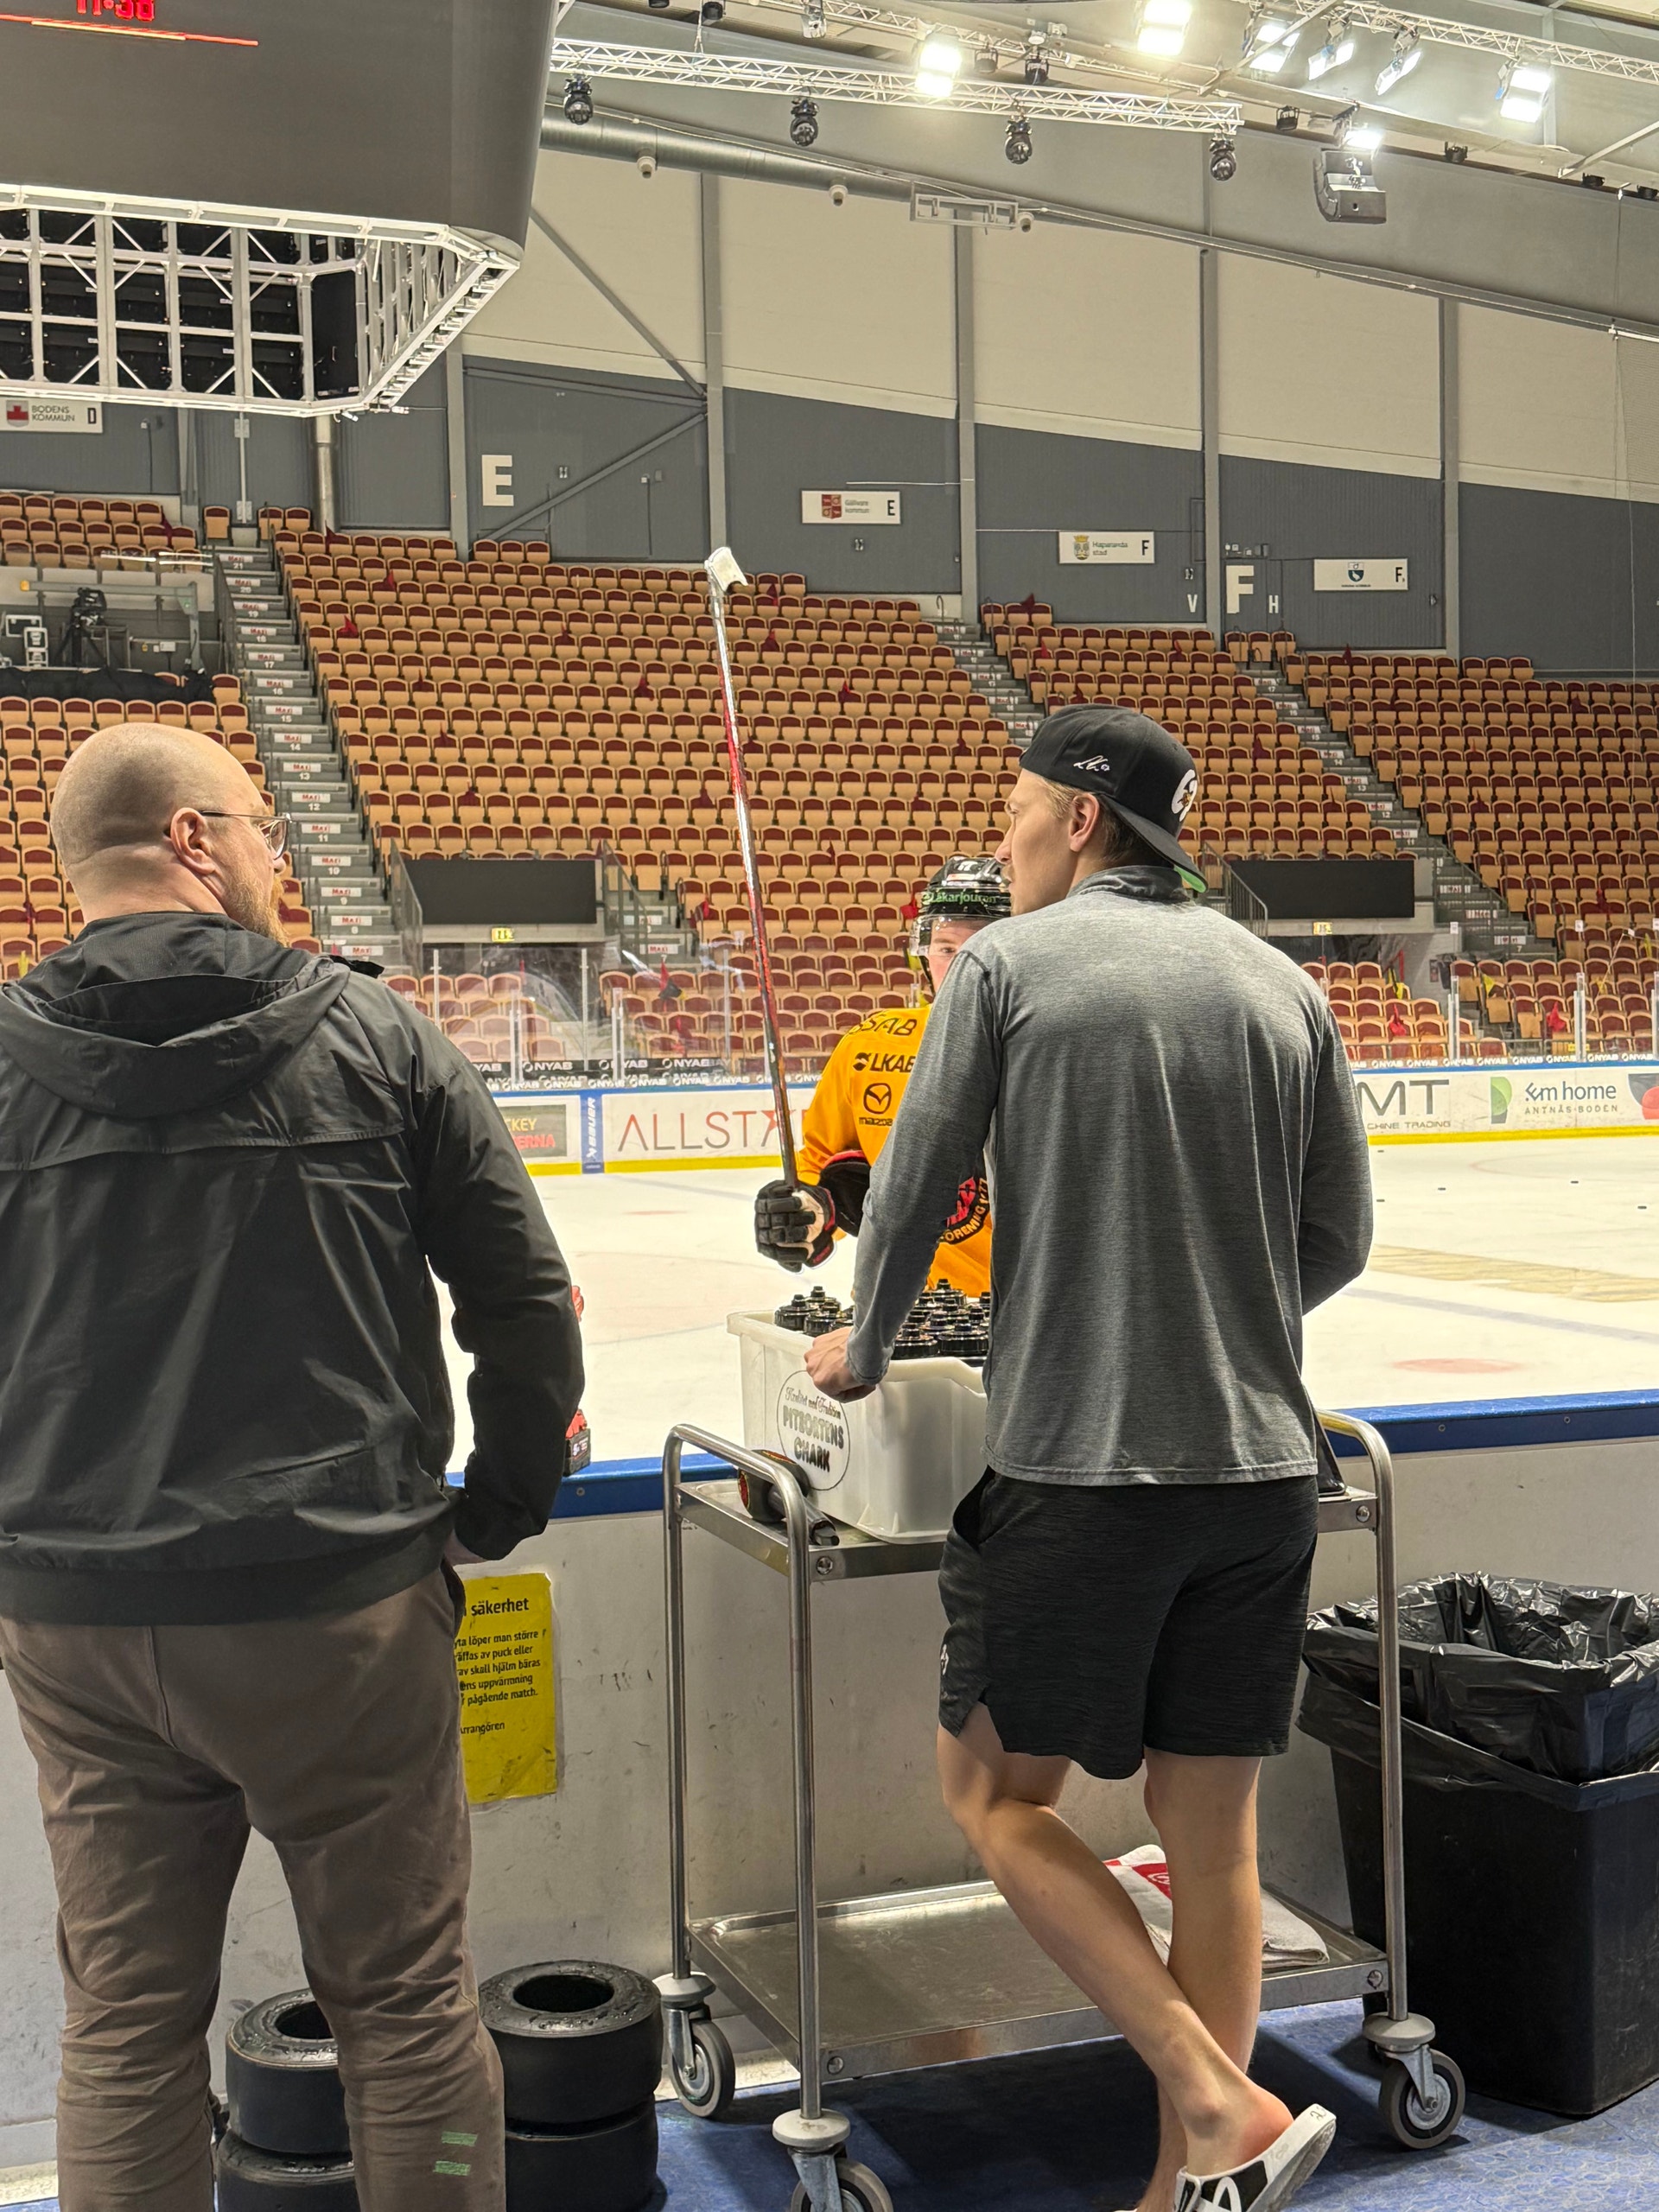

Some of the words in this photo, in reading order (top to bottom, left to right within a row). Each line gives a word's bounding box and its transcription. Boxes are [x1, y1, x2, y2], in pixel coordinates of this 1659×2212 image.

[31, 405, 70, 414] BODENS
[87, 407, 97, 424] D
[481, 454, 514, 506] E
[887, 500, 895, 516] E
[1141, 540, 1150, 556] F
[1395, 567, 1403, 582] F
[1225, 565, 1254, 614] F
[1186, 594, 1198, 613] V
[1268, 594, 1279, 613] H
[327, 867, 340, 875] 10
[534, 1061, 573, 1071] NYAB
[1414, 1058, 1439, 1067] NYAB
[1484, 1056, 1508, 1065] NYAB
[1520, 1055, 1543, 1064] NYAB
[548, 1080, 582, 1090] NYAB
[637, 1077, 667, 1086] NYAB
[721, 1075, 750, 1084] NYAB
[1562, 1080, 1617, 1101] home
[1578, 1103, 1618, 1114] BODEN
[587, 1097, 597, 1147] BAUER
[794, 1436, 830, 1473] CHARK
[471, 1598, 530, 1616] säkerhet
[468, 1635, 491, 1647] löper
[493, 1634, 512, 1643] man
[514, 1630, 538, 1641] större
[493, 1647, 512, 1660] puck
[514, 1645, 533, 1656] eller
[470, 1664, 491, 1675] skall
[493, 1662, 516, 1674] hjälm
[518, 1658, 541, 1669] bäras
[478, 1675, 533, 1690] uppvärmning
[467, 1691, 509, 1707] pågående
[510, 1687, 538, 1699] match.
